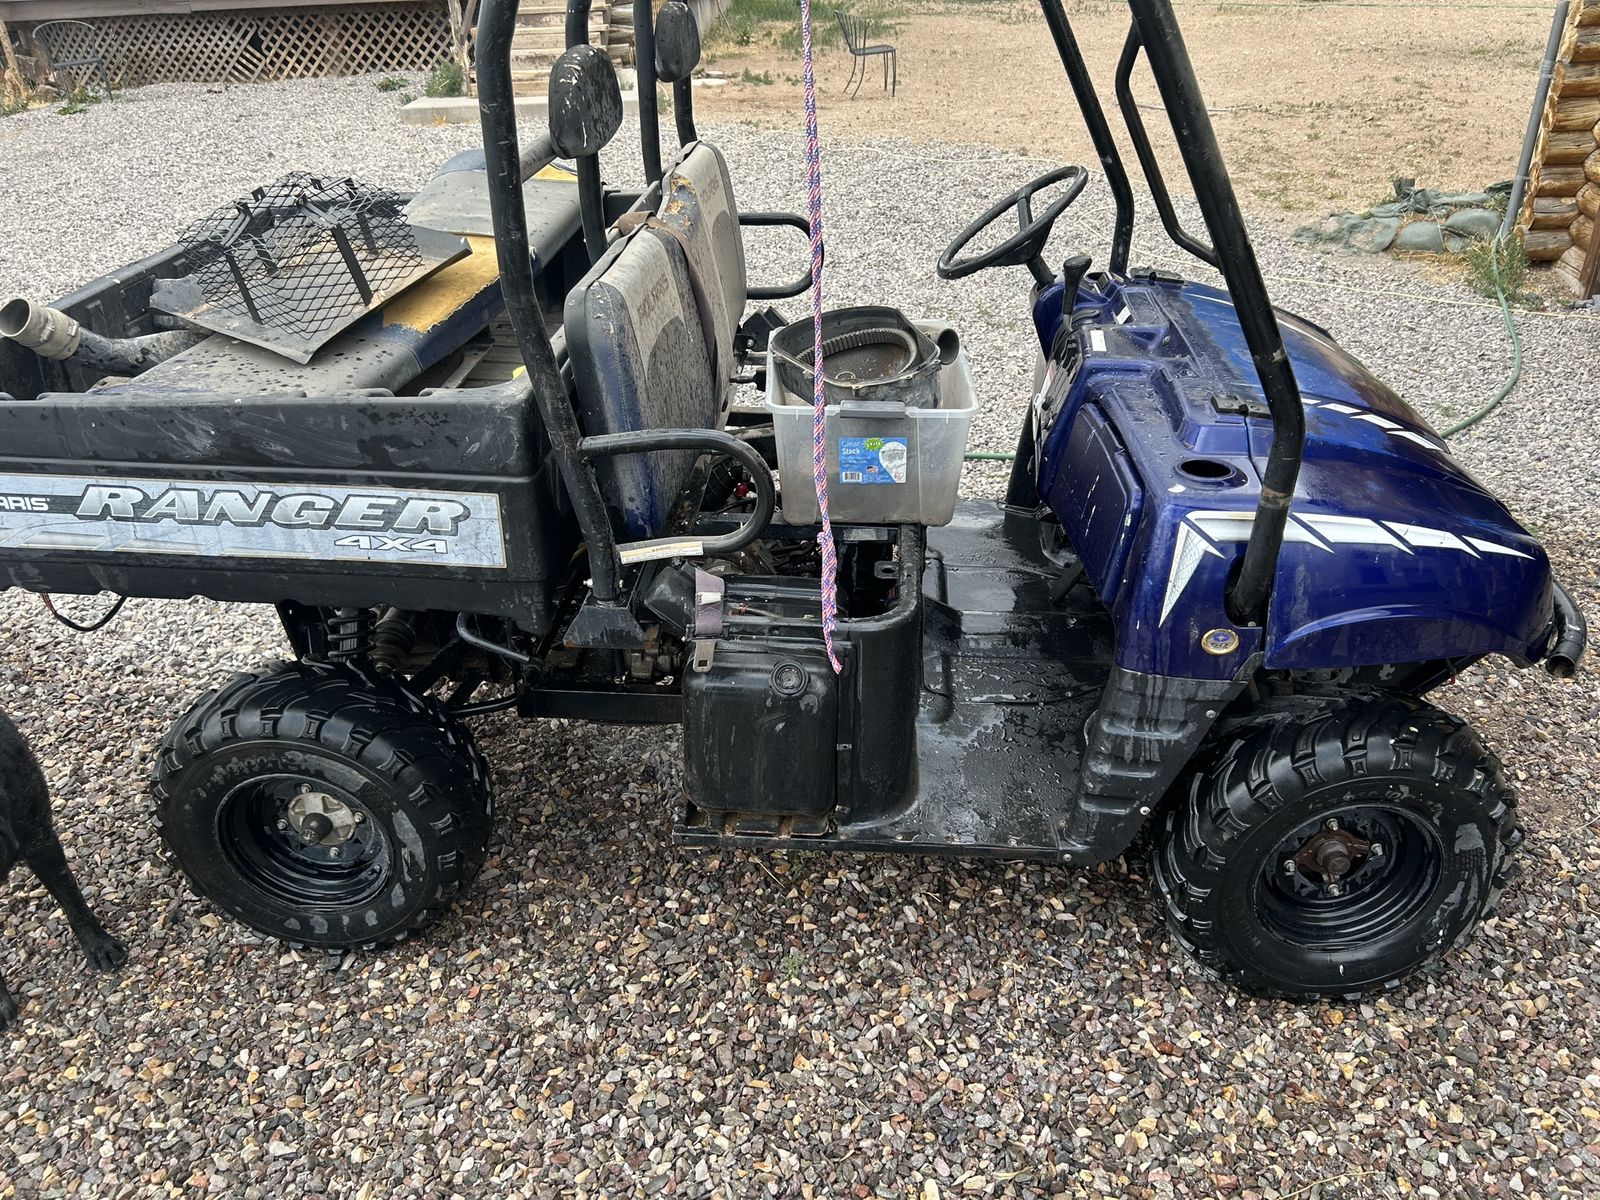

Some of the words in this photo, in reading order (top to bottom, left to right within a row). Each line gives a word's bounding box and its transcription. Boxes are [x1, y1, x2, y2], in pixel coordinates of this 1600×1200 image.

[841, 440, 861, 448] Clear
[841, 447, 861, 455] Stack
[76, 485, 469, 535] RANGER
